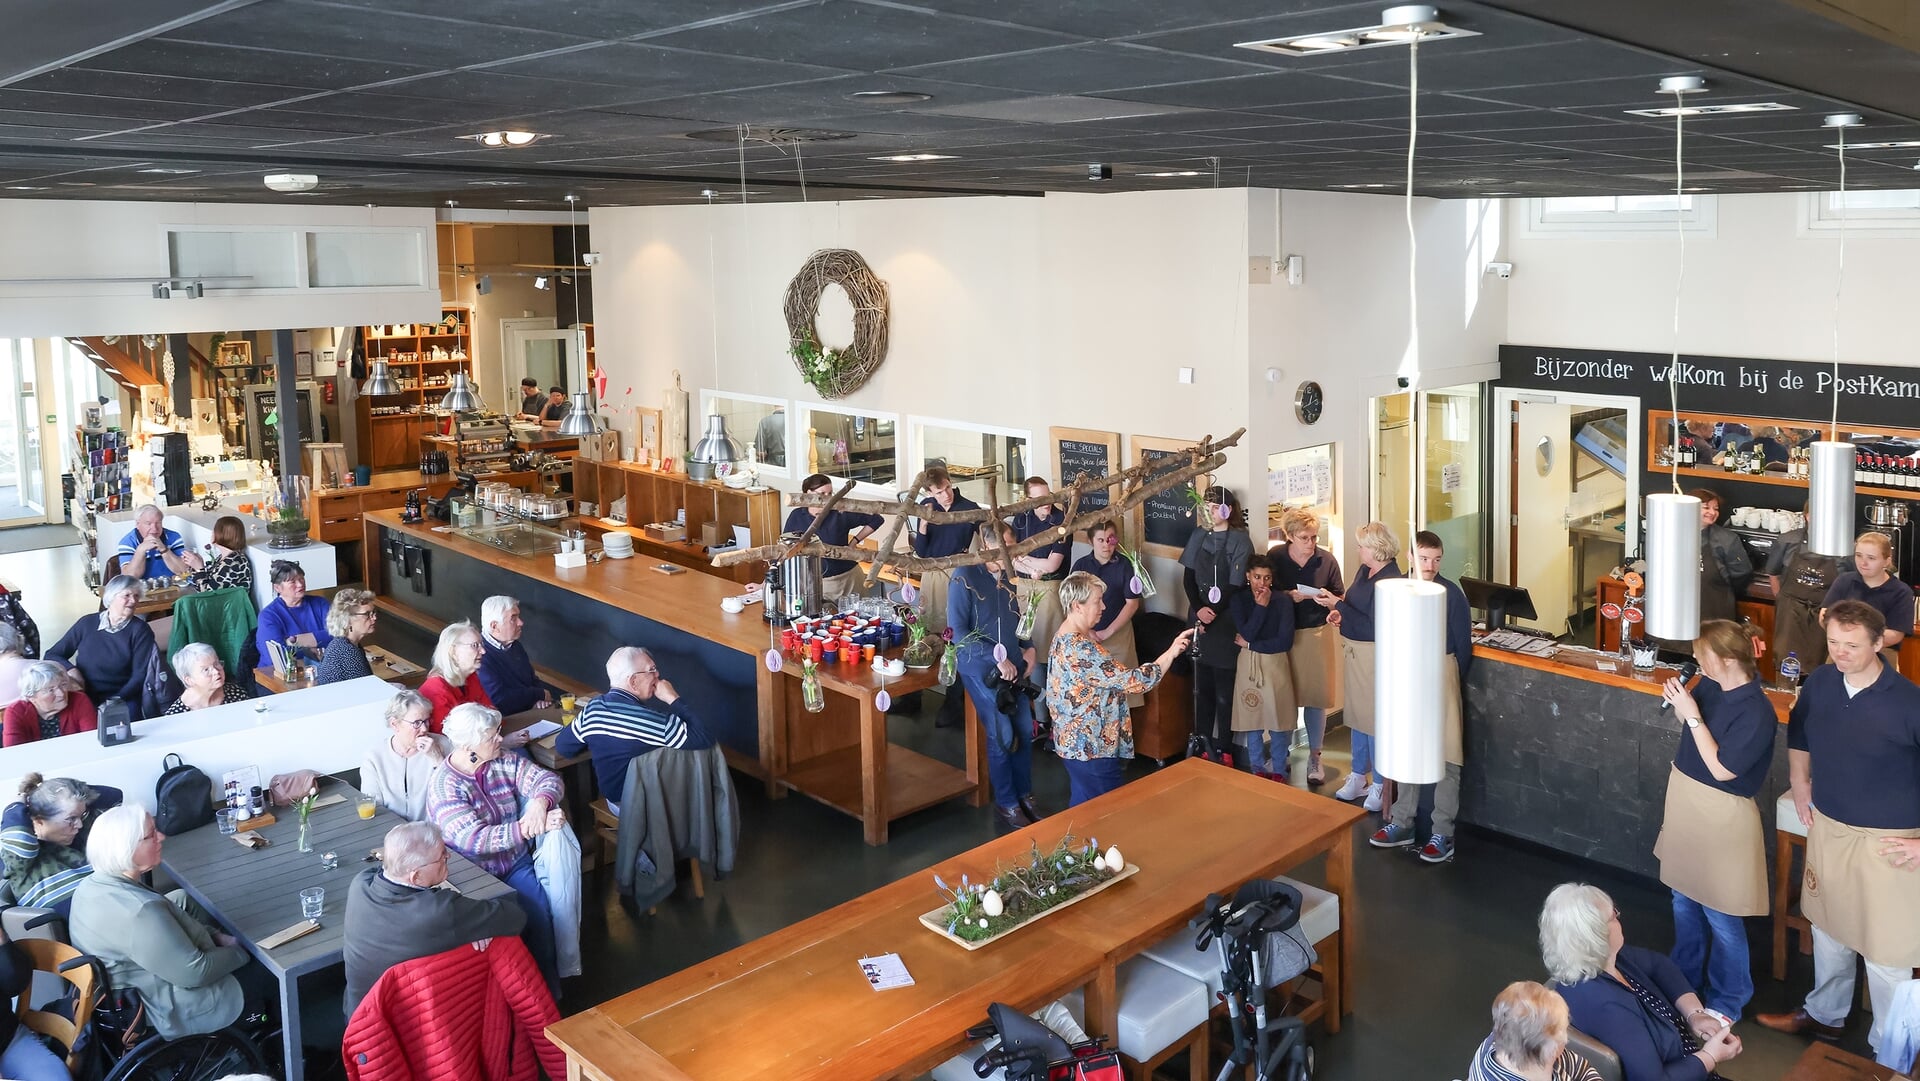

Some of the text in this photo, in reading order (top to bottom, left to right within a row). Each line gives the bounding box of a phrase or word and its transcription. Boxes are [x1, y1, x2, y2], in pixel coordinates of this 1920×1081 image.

[1534, 356, 1634, 381] Bijzonder
[1739, 366, 1769, 394] bij
[1779, 369, 1804, 390] de
